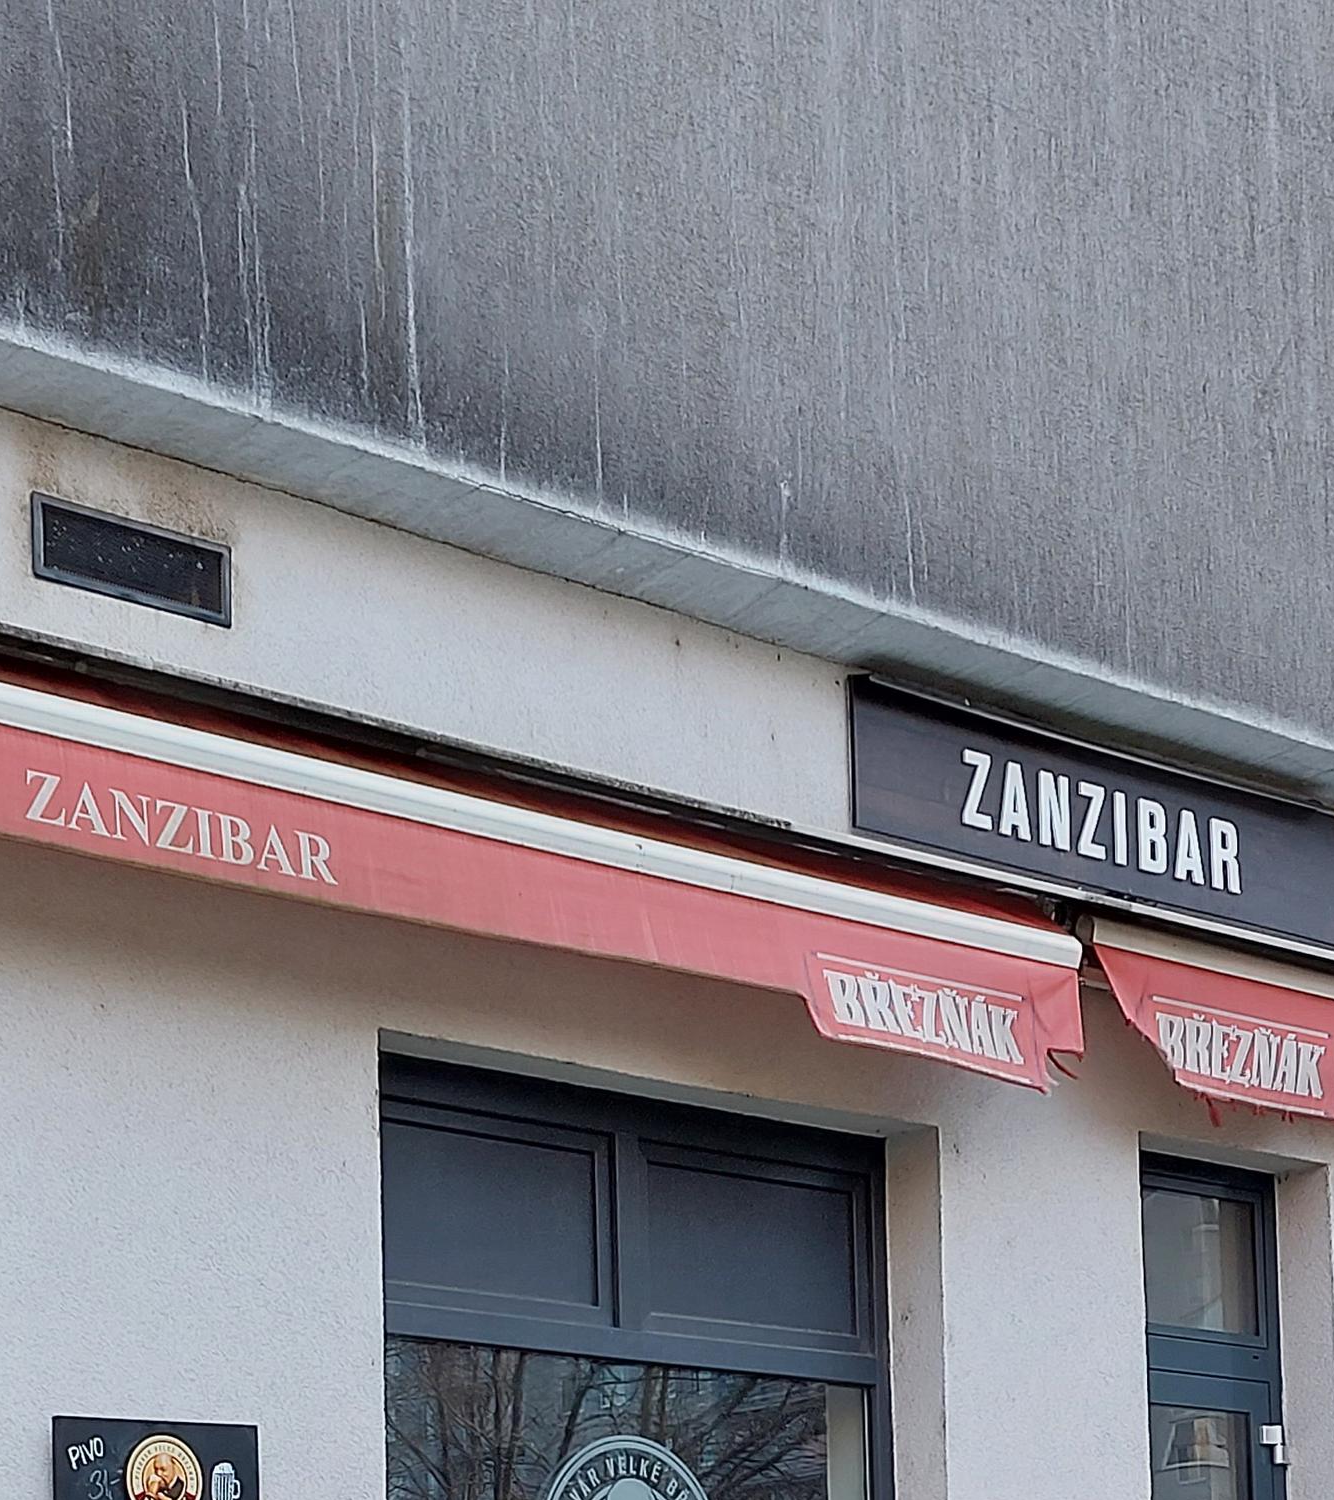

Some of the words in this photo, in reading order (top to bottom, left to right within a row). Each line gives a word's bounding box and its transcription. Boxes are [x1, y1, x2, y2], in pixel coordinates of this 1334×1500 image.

[24, 768, 339, 886] ZANZIBAR
[960, 747, 1243, 895] ZANZIBAR
[822, 968, 1026, 1065] BŘEZŇÁK
[1155, 1009, 1326, 1099] BŘEZŇÁK
[67, 1437, 104, 1470] PIVO
[604, 1454, 663, 1484] VELKÉ
